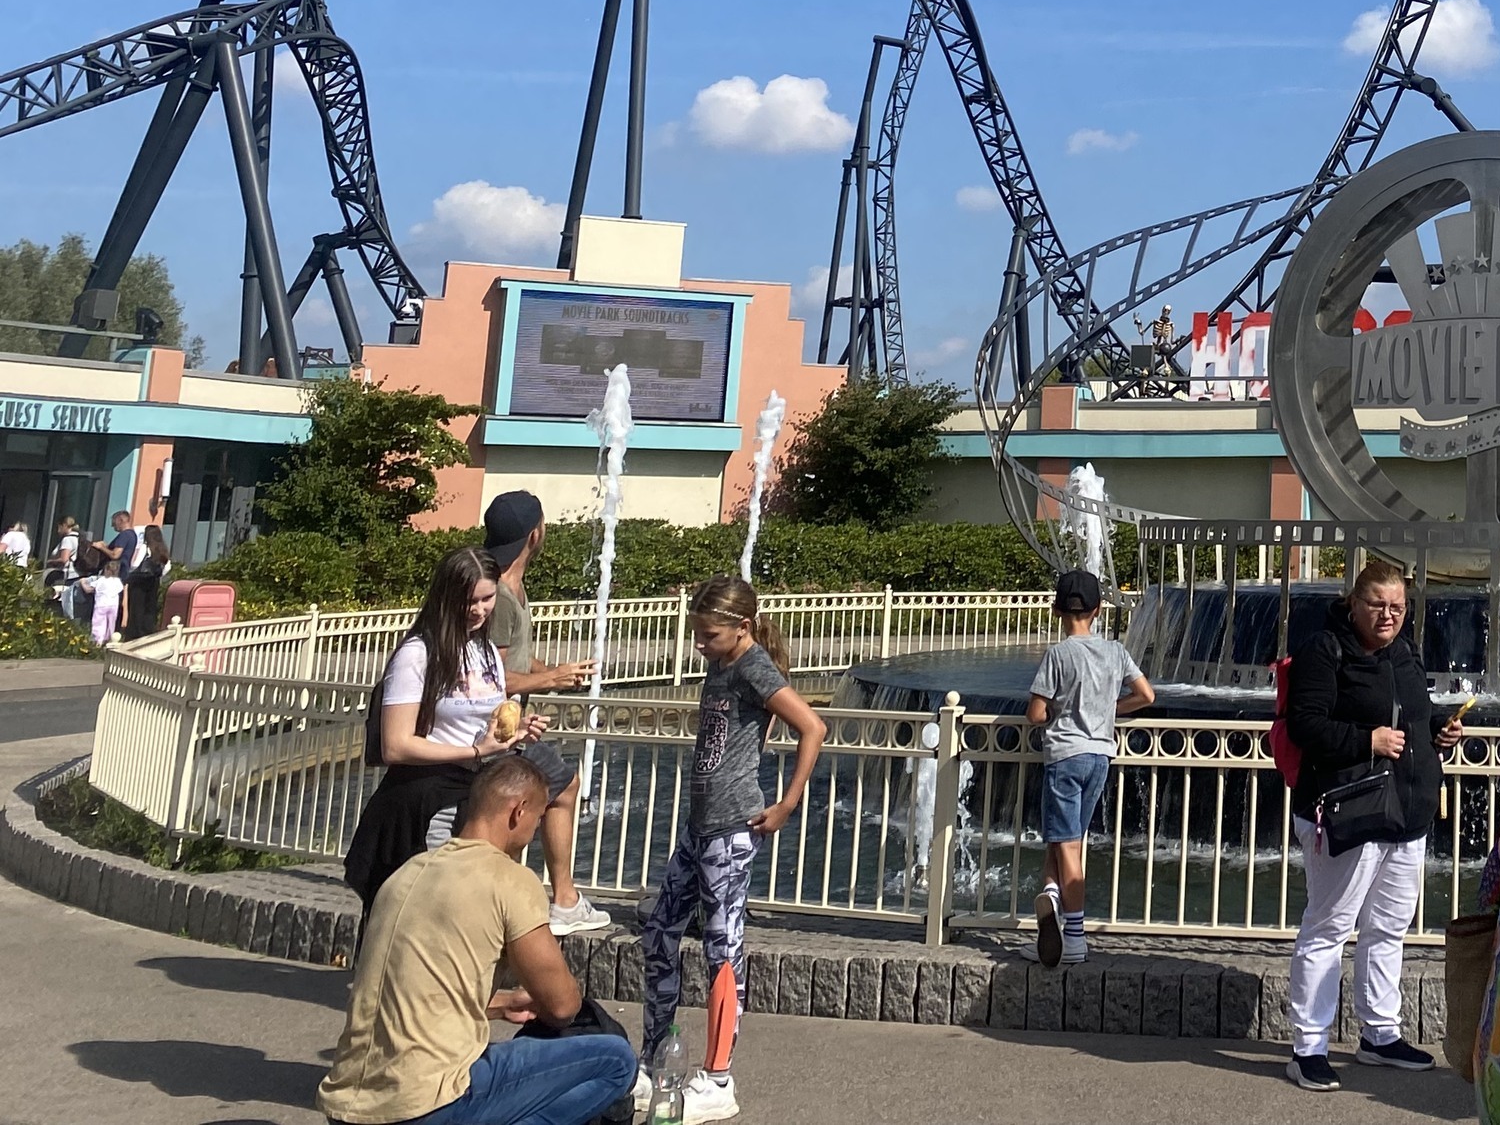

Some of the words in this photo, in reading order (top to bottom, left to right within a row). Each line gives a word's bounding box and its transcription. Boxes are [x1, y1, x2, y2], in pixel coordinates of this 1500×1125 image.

[561, 304, 592, 320] MOVIE
[595, 306, 621, 322] PARK
[624, 308, 690, 325] SOUNDTRACKS
[1353, 322, 1484, 406] MOVIE
[51, 404, 112, 433] SERVICE
